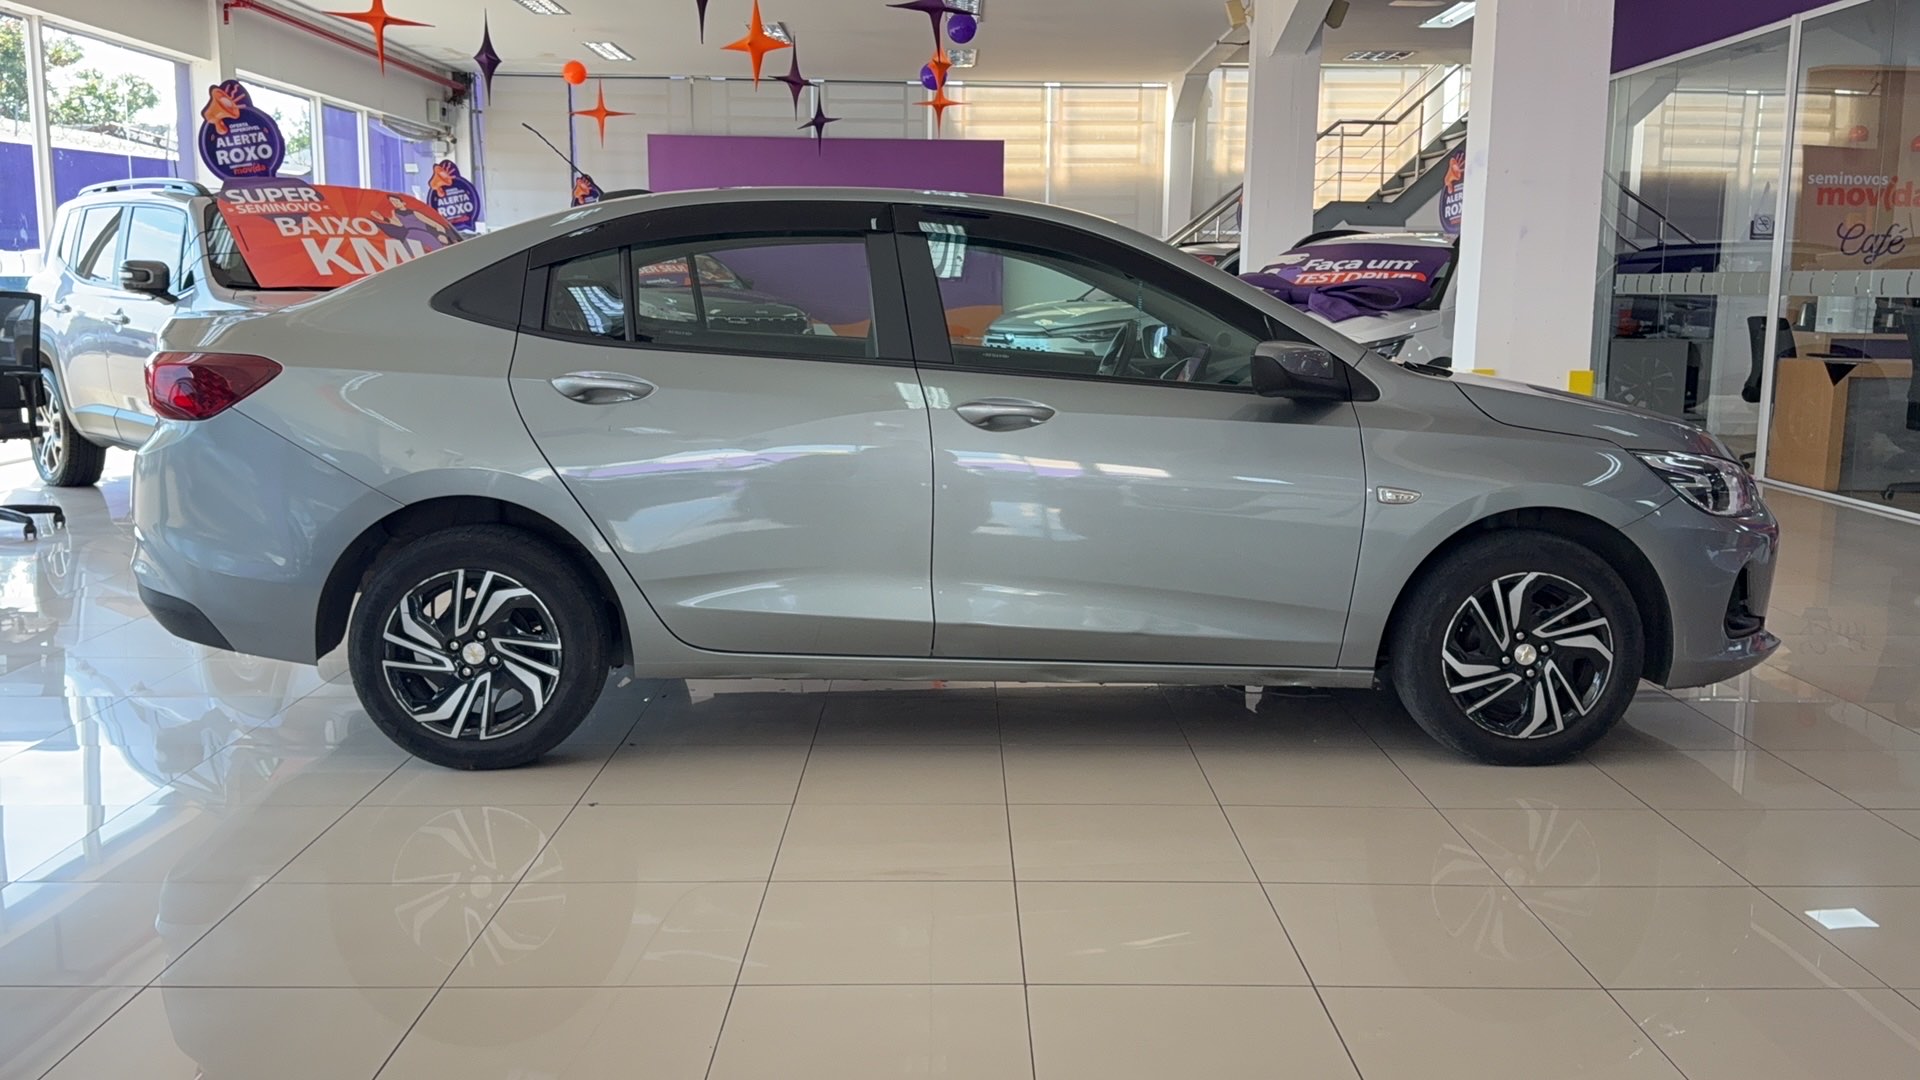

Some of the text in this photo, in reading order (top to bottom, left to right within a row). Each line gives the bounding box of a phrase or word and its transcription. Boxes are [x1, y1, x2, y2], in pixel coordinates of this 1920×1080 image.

[216, 132, 267, 148] ALERTA
[216, 144, 273, 165] ROXO
[233, 162, 267, 175] movida
[1808, 171, 1889, 186] seminovos
[225, 187, 320, 205] SUPER
[437, 193, 470, 206] ALERTA
[1446, 192, 1464, 204] ALER
[235, 202, 322, 214] SEMINOVO
[437, 201, 474, 217] ROXO
[274, 216, 379, 237] BAIXO
[1837, 222, 1908, 265] Café
[1302, 258, 1415, 272] Faça um
[1294, 272, 1345, 285] TEST
